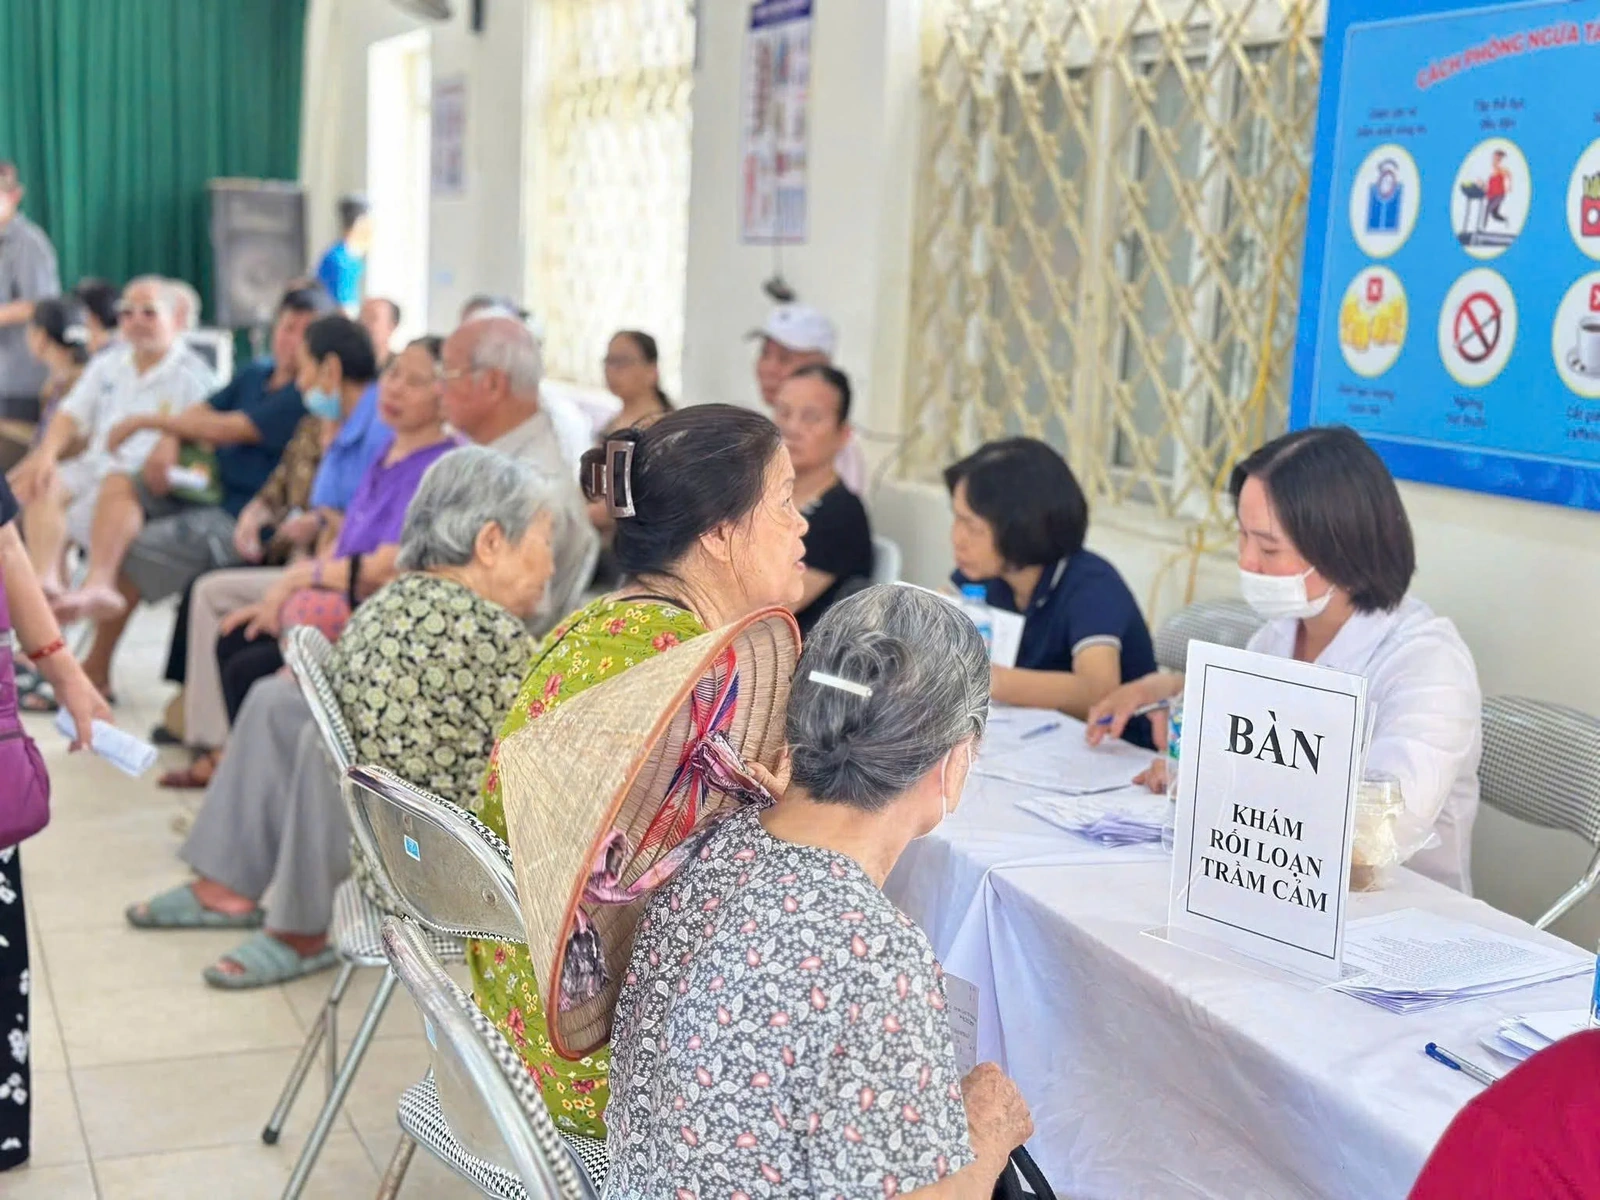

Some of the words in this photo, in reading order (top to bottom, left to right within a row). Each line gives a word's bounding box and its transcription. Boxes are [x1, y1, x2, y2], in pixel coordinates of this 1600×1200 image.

[1224, 710, 1325, 775] BÀN
[1232, 803, 1304, 841] KHÁM
[1209, 828, 1251, 858] RỐI
[1256, 841, 1323, 879] LOẠN
[1201, 856, 1266, 894] TRẦM
[1272, 873, 1328, 912] CẢM
